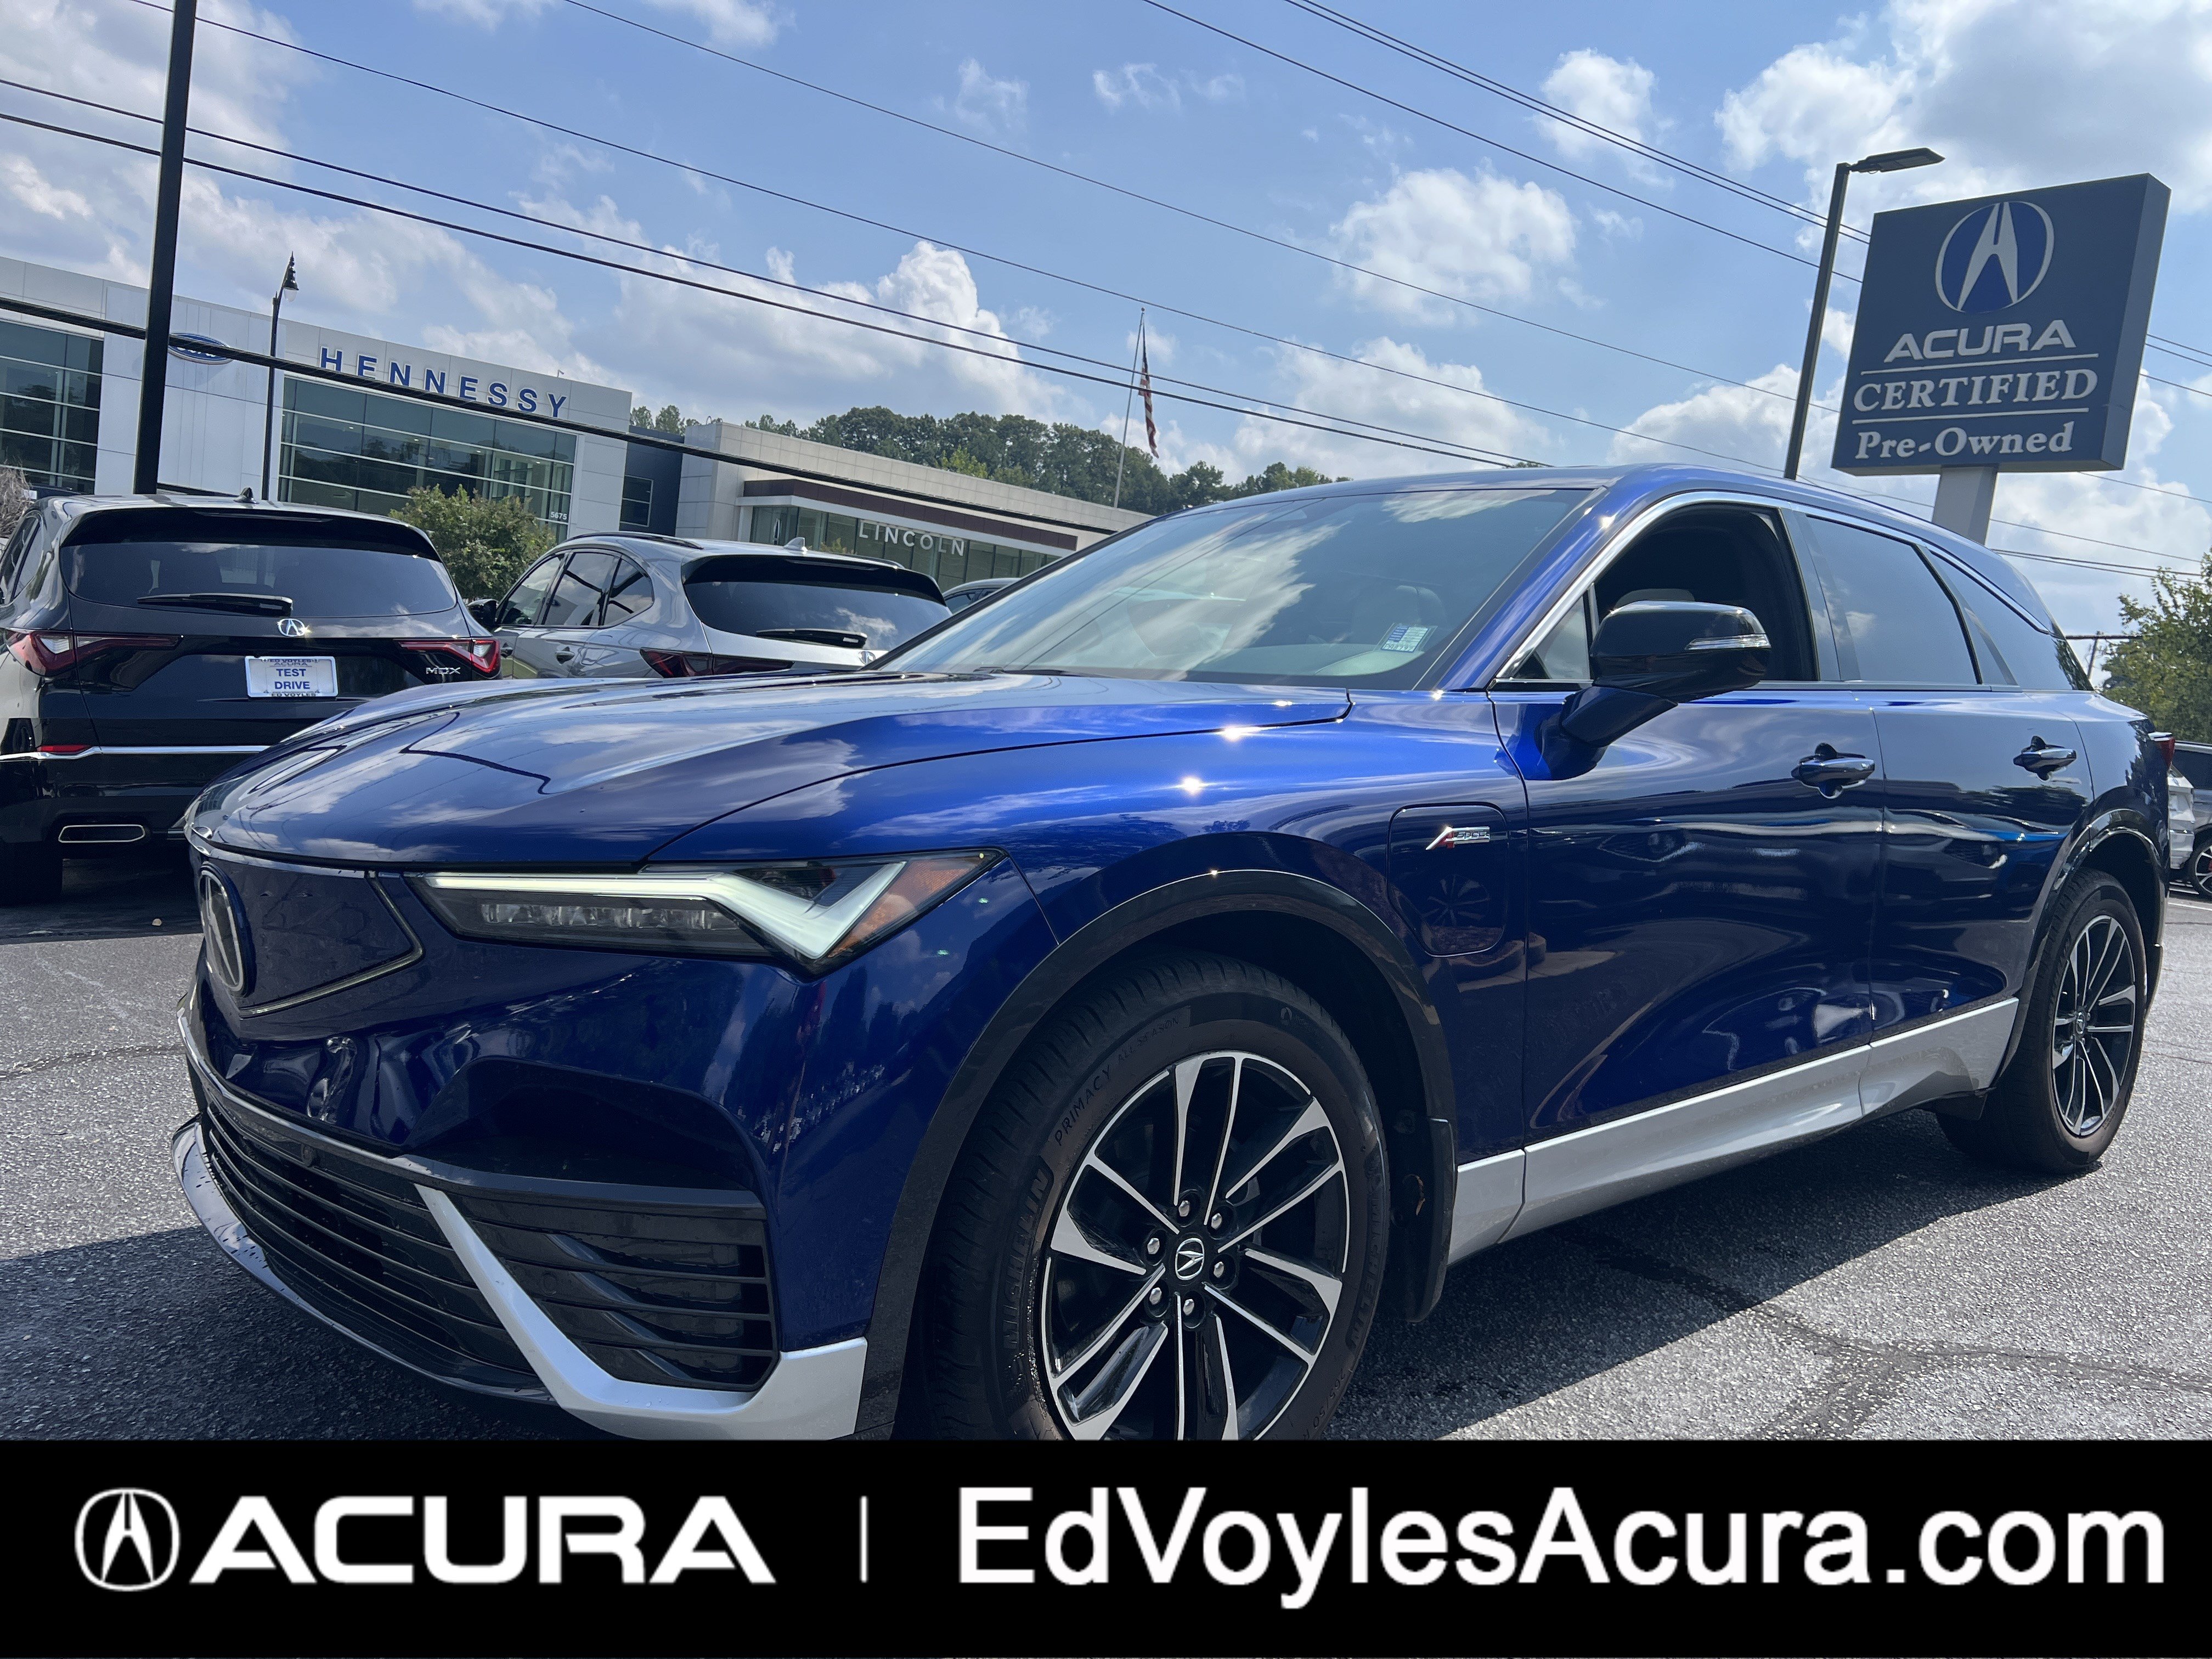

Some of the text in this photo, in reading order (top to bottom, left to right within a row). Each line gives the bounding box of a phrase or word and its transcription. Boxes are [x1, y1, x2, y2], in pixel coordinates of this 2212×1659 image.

[1884, 319, 2076, 363] ACURA
[320, 347, 567, 417] HENNESSY
[1854, 369, 2098, 412] CERTIFIED
[1855, 421, 2074, 459] Pre-Owned
[550, 511, 567, 520] 5675
[859, 521, 964, 557] LINCOLN
[274, 681, 310, 689] DRIVE
[426, 667, 461, 675] MDX
[1054, 1065, 1110, 1147] PRIMACY
